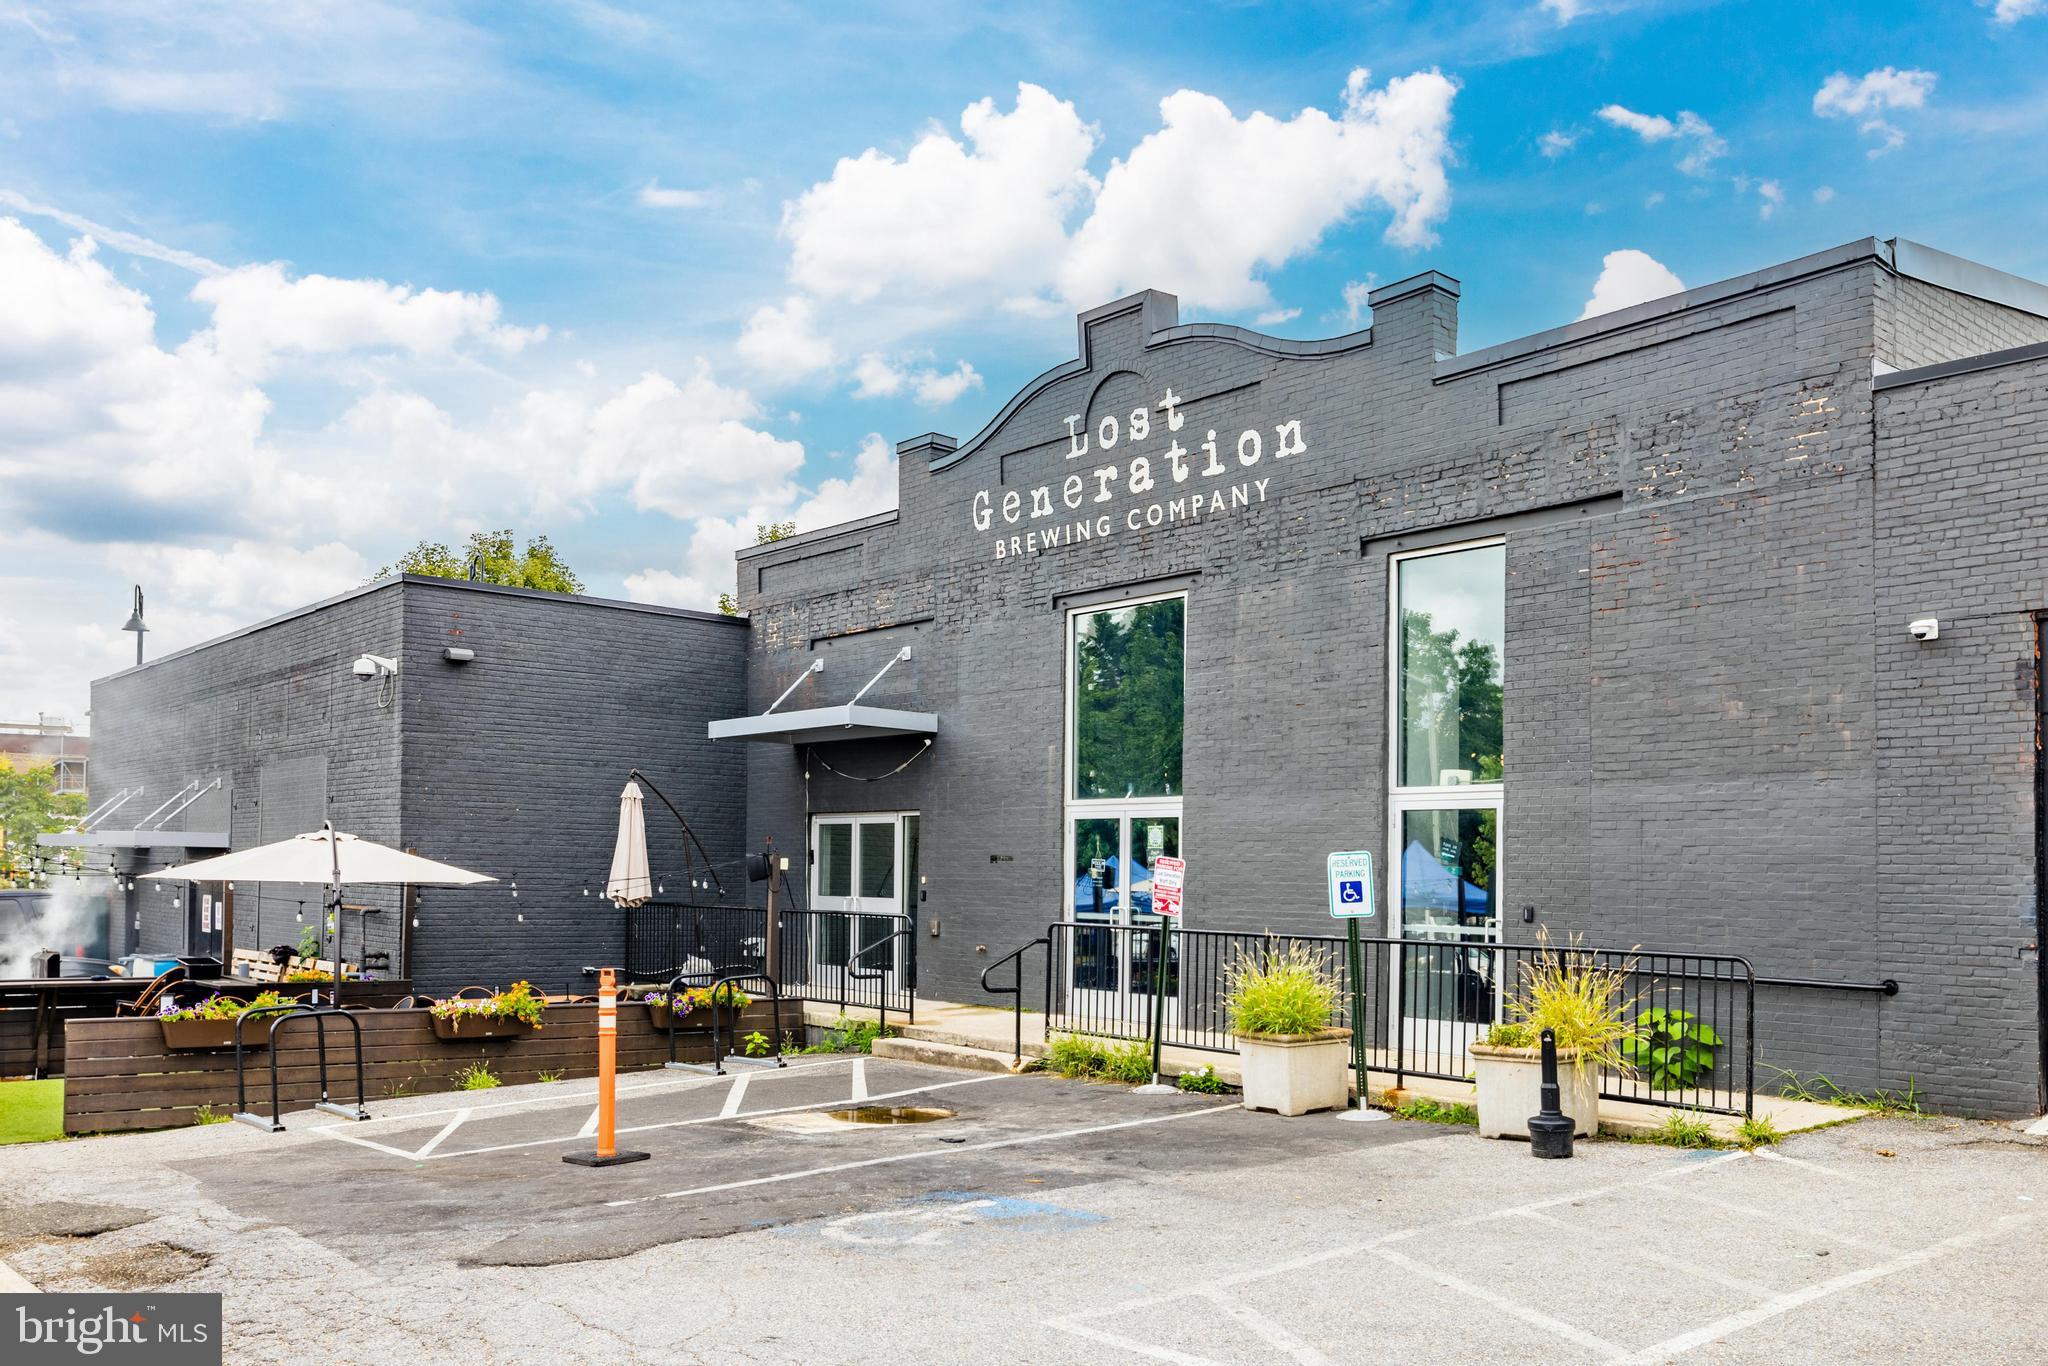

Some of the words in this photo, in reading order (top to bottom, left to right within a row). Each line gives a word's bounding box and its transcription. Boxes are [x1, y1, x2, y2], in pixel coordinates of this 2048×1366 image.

[1063, 387, 1185, 460] Lost
[972, 419, 1307, 532] Generation
[995, 515, 1111, 560] BREWING
[1127, 477, 1271, 531] COMPANY
[1333, 858, 1367, 868] RESERVED
[1335, 869, 1365, 878] PARKING
